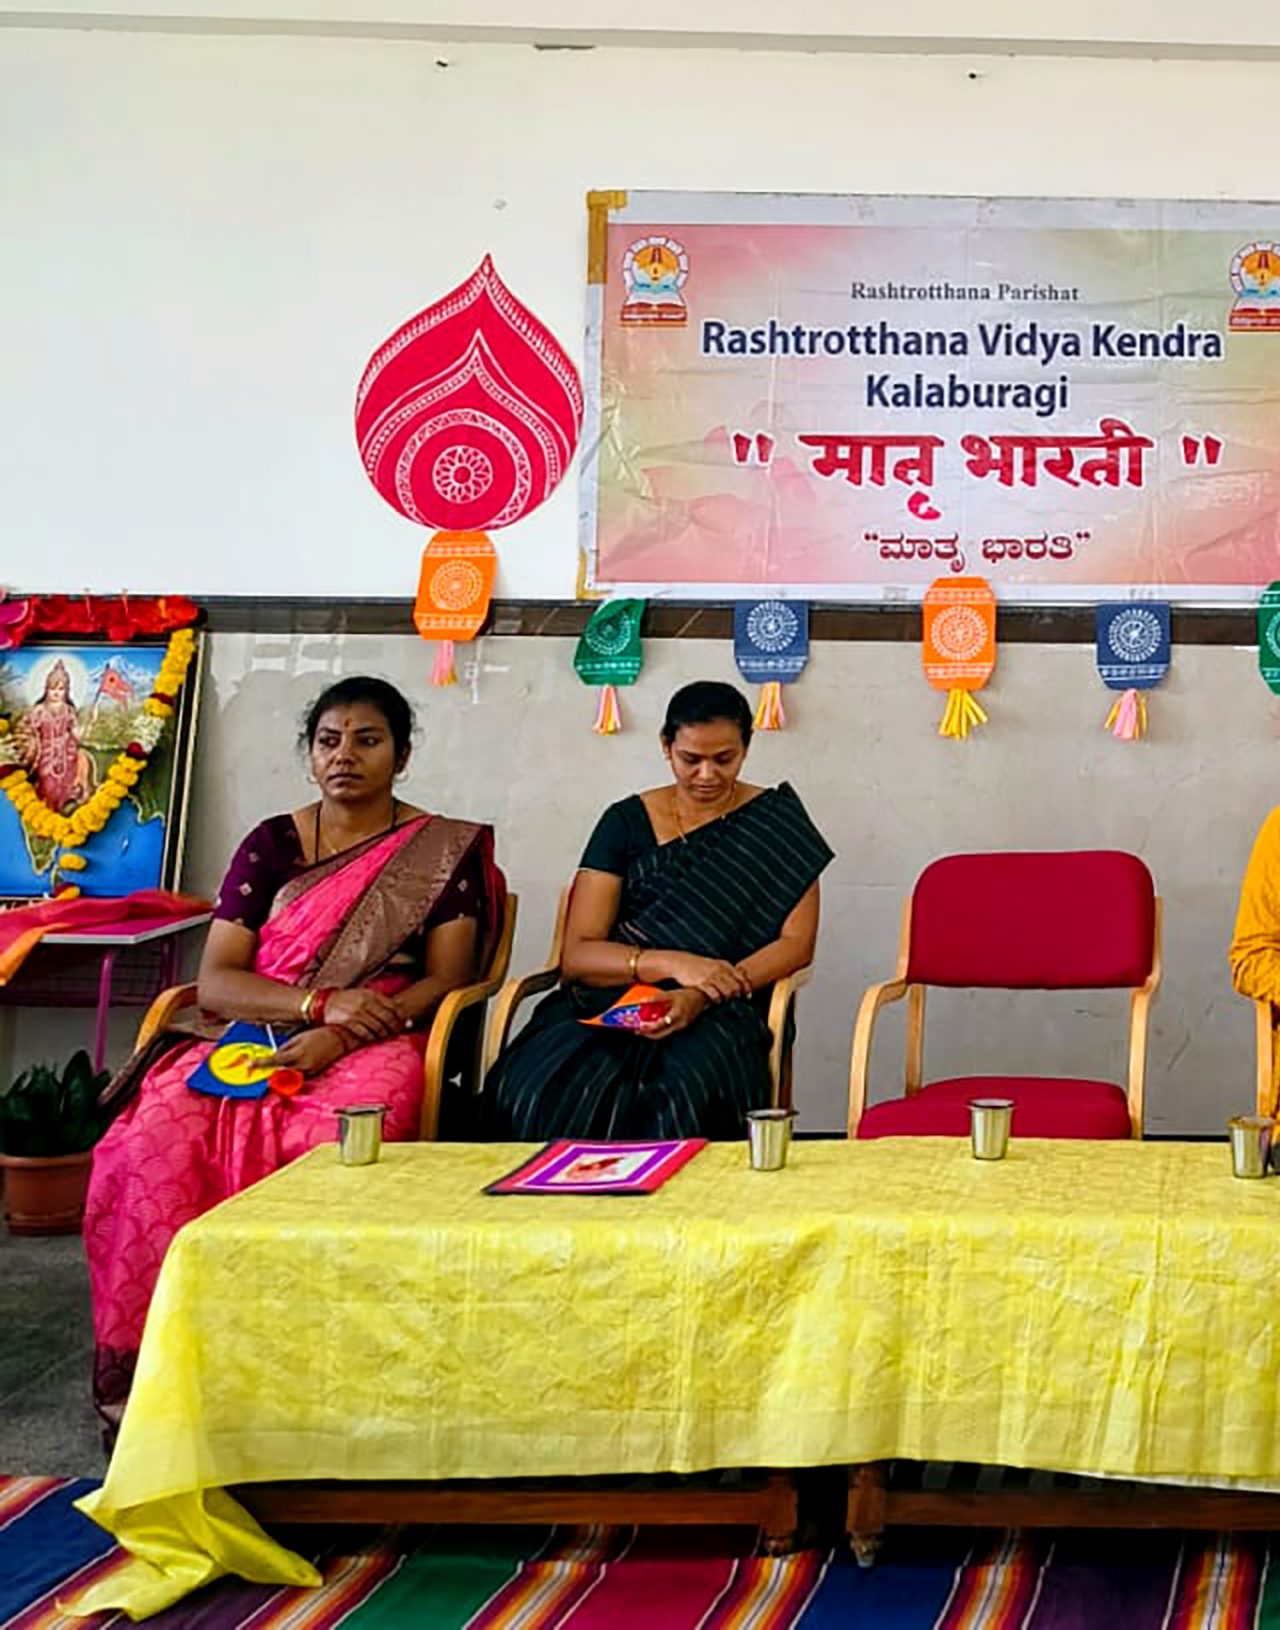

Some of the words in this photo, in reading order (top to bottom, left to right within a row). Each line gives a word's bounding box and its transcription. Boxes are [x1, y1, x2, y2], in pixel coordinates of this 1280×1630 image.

[852, 282, 990, 300] Rashtrotthana
[998, 283, 1079, 301] Parishat
[702, 320, 969, 356] Rashtrotthana
[979, 323, 1081, 365] Vidya
[1092, 324, 1222, 358] Kendra
[867, 374, 1069, 417] Kalaburagi
[799, 435, 944, 520] मातृ
[960, 418, 1153, 487] भारती
